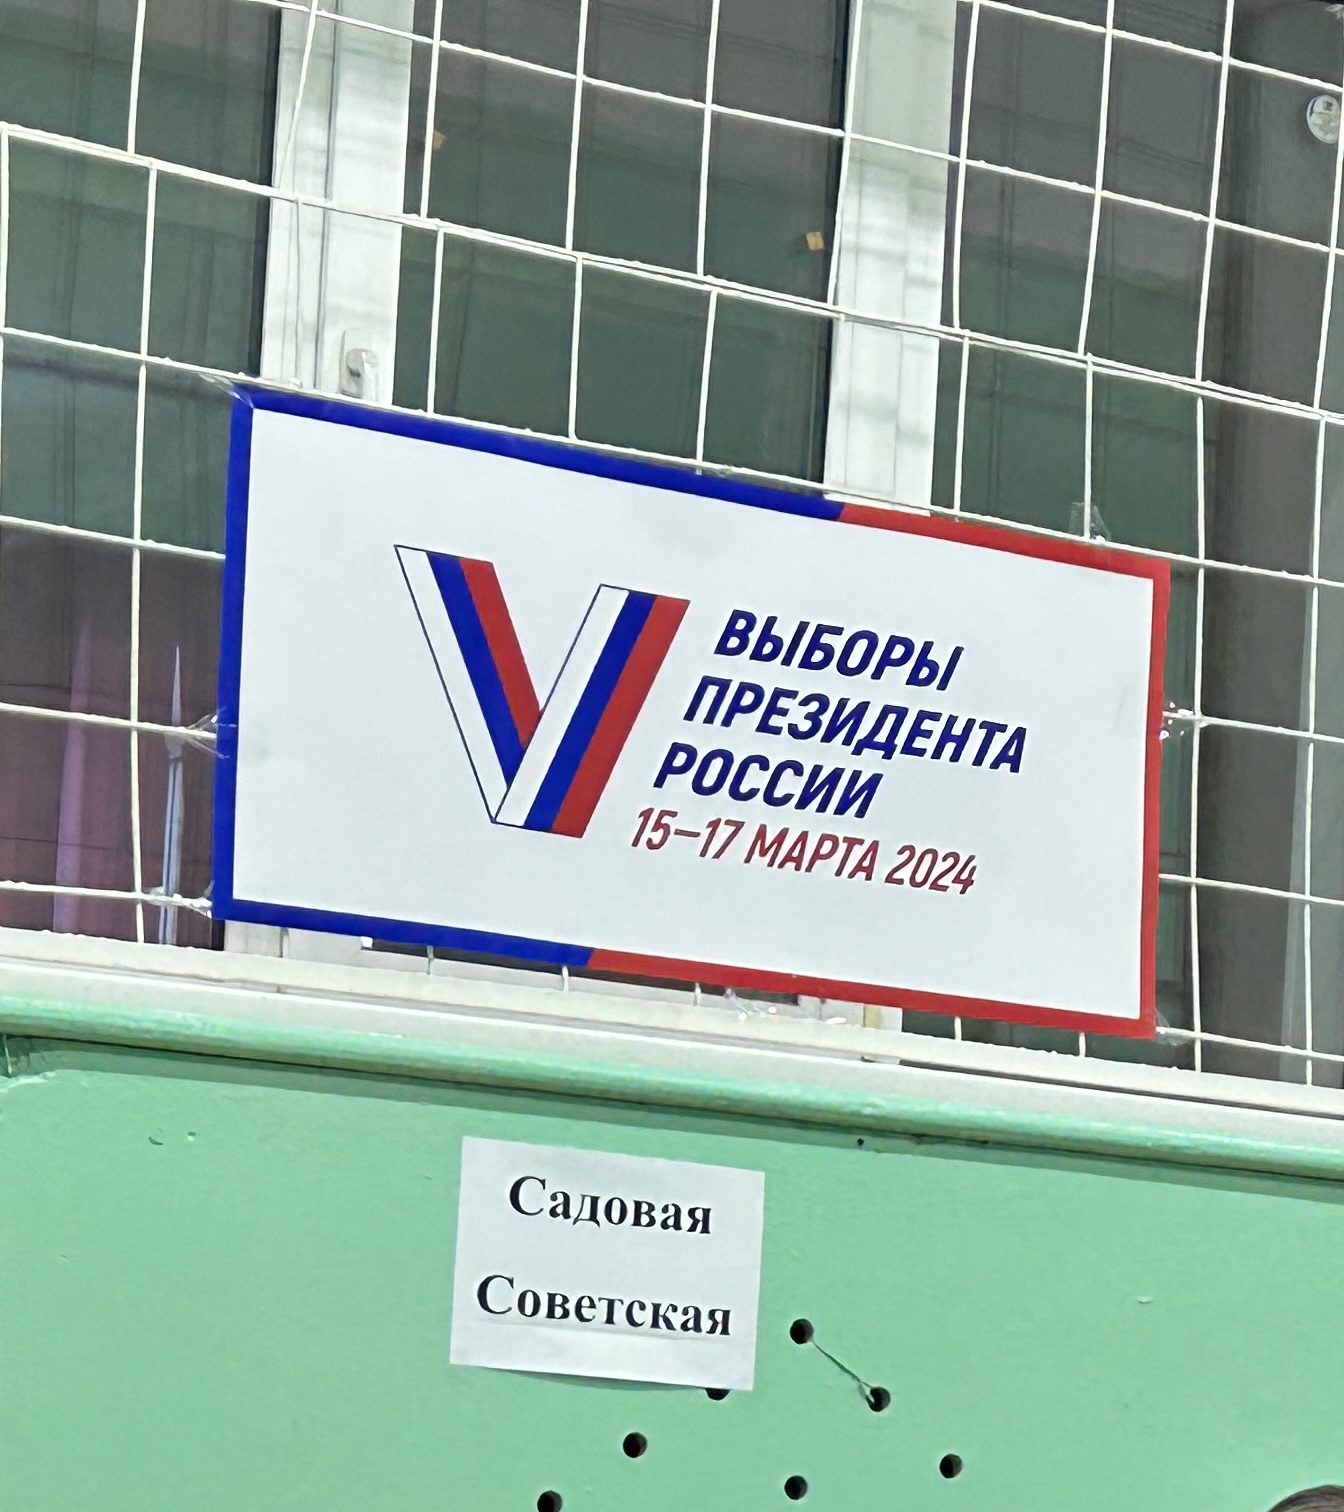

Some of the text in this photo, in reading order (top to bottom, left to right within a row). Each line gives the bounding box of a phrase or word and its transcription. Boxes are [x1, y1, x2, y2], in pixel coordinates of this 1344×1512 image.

[714, 609, 964, 691] ВЫБОРЫ
[683, 675, 1027, 773] ПРЕЗИДЕНТА
[654, 743, 884, 819] РОССИИ
[744, 824, 880, 881] МАРТА
[884, 845, 978, 895] 2024
[508, 1175, 712, 1234] Садовая
[476, 1274, 732, 1336] Советская
